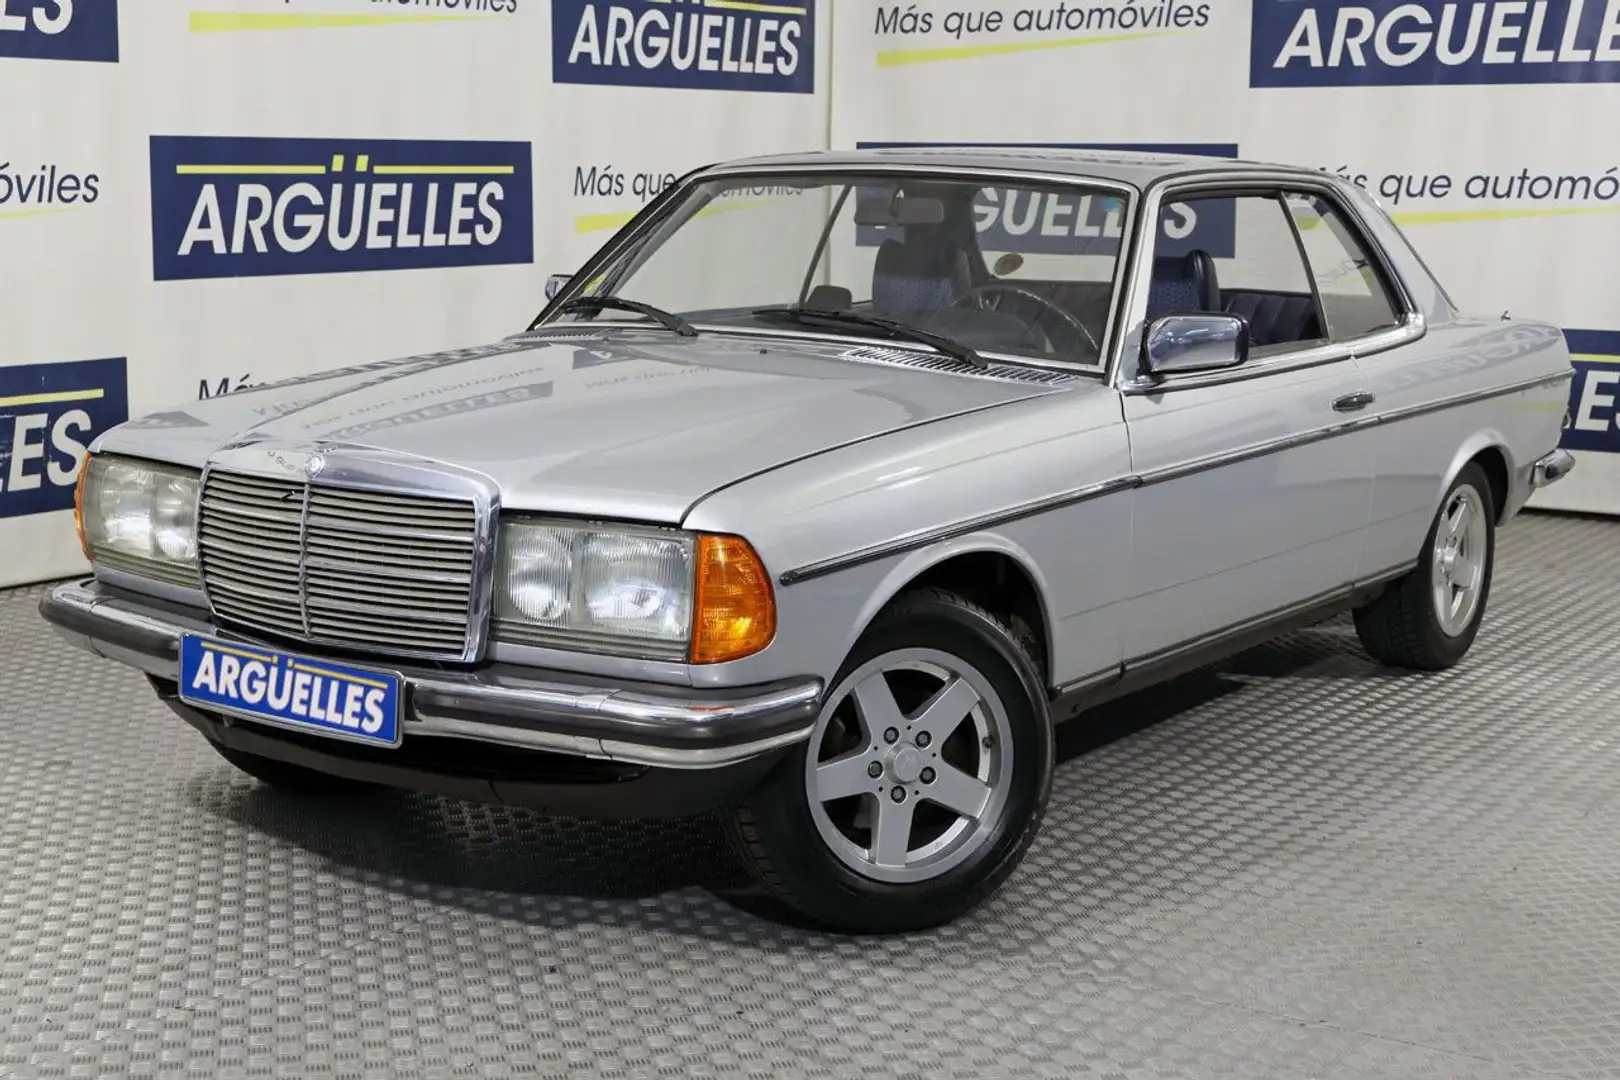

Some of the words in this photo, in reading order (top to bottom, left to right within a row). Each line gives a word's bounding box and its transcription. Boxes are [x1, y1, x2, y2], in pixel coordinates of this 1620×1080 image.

[874, 5, 933, 34] Más
[943, 9, 1003, 39] que
[1013, 0, 1210, 31] automóviles
[574, 165, 624, 196] Más
[1380, 173, 1452, 205] que
[178, 155, 504, 256] ARGÜELLES
[192, 651, 385, 733] ARGÜELLES
